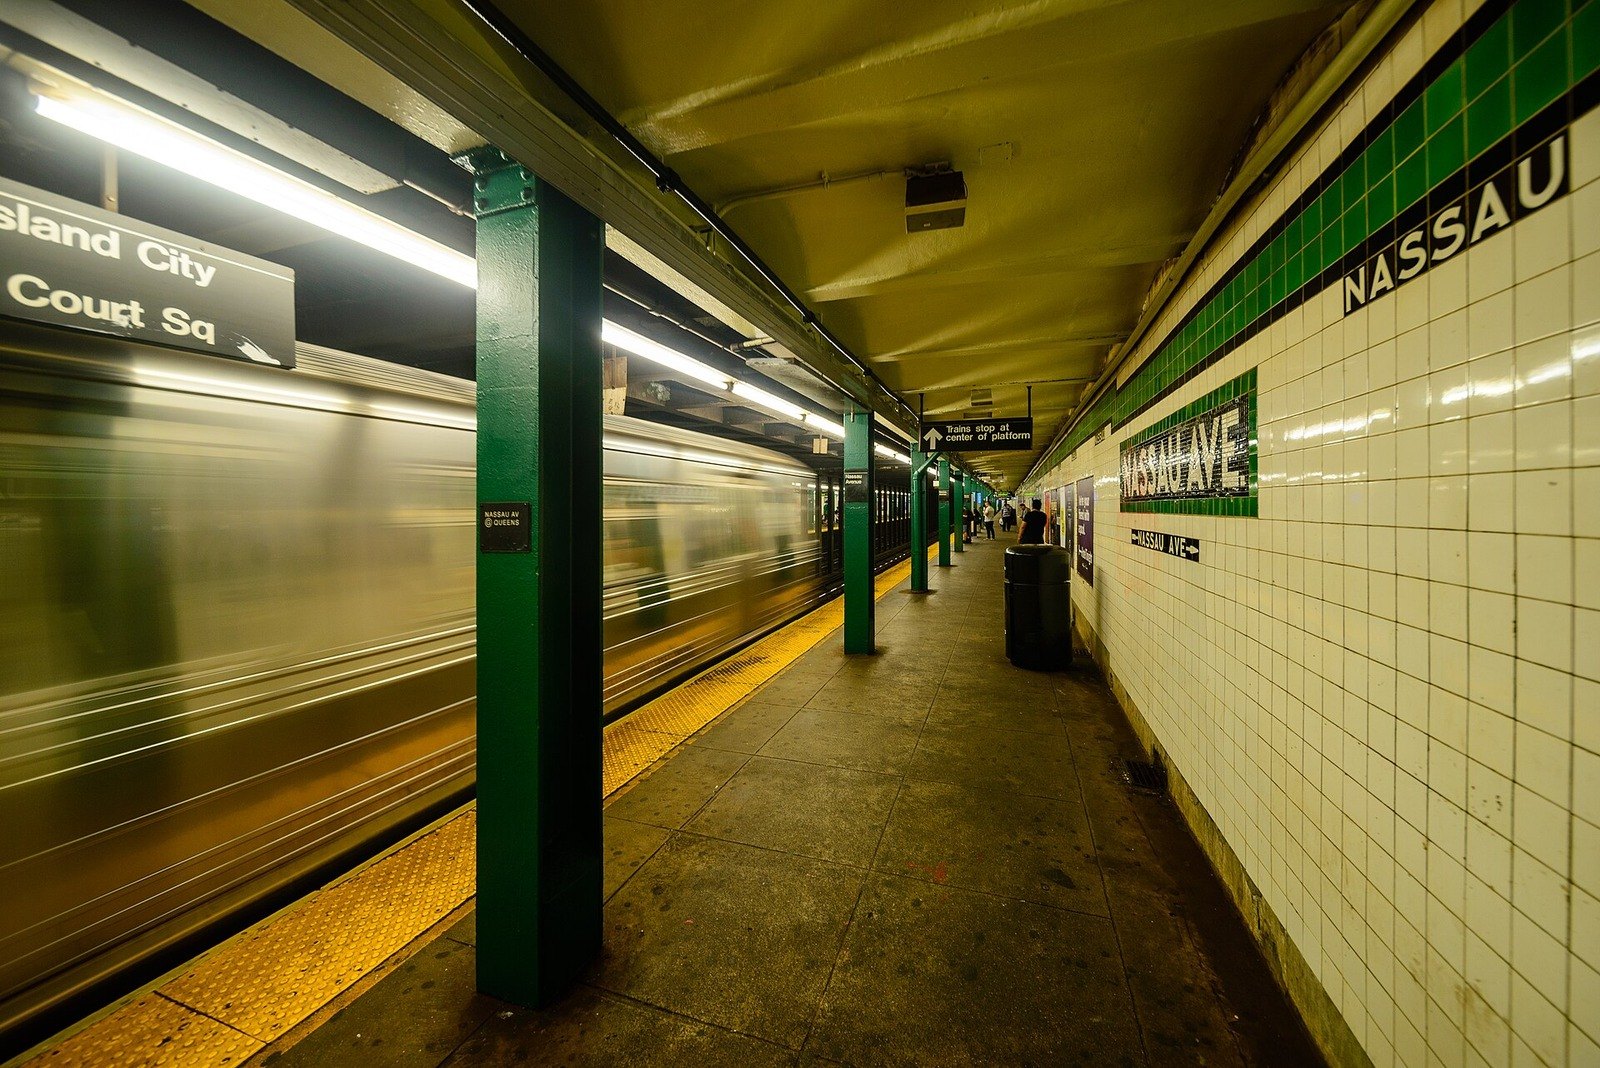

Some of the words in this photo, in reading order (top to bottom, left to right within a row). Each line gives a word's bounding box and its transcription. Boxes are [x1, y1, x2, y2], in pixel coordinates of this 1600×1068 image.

[1344, 135, 1566, 314] NASSAU
[136, 240, 217, 288] City
[6, 273, 146, 328] Court
[161, 306, 216, 346] Sq
[945, 425, 971, 434] Trains
[975, 424, 996, 434] stop
[1000, 423, 1010, 432] at
[945, 433, 973, 442] center
[977, 432, 987, 441] of
[991, 431, 1031, 442] platform
[1123, 431, 1182, 497] NASSAU
[1137, 530, 1164, 551] NASSAU
[1168, 536, 1187, 558] AVE
